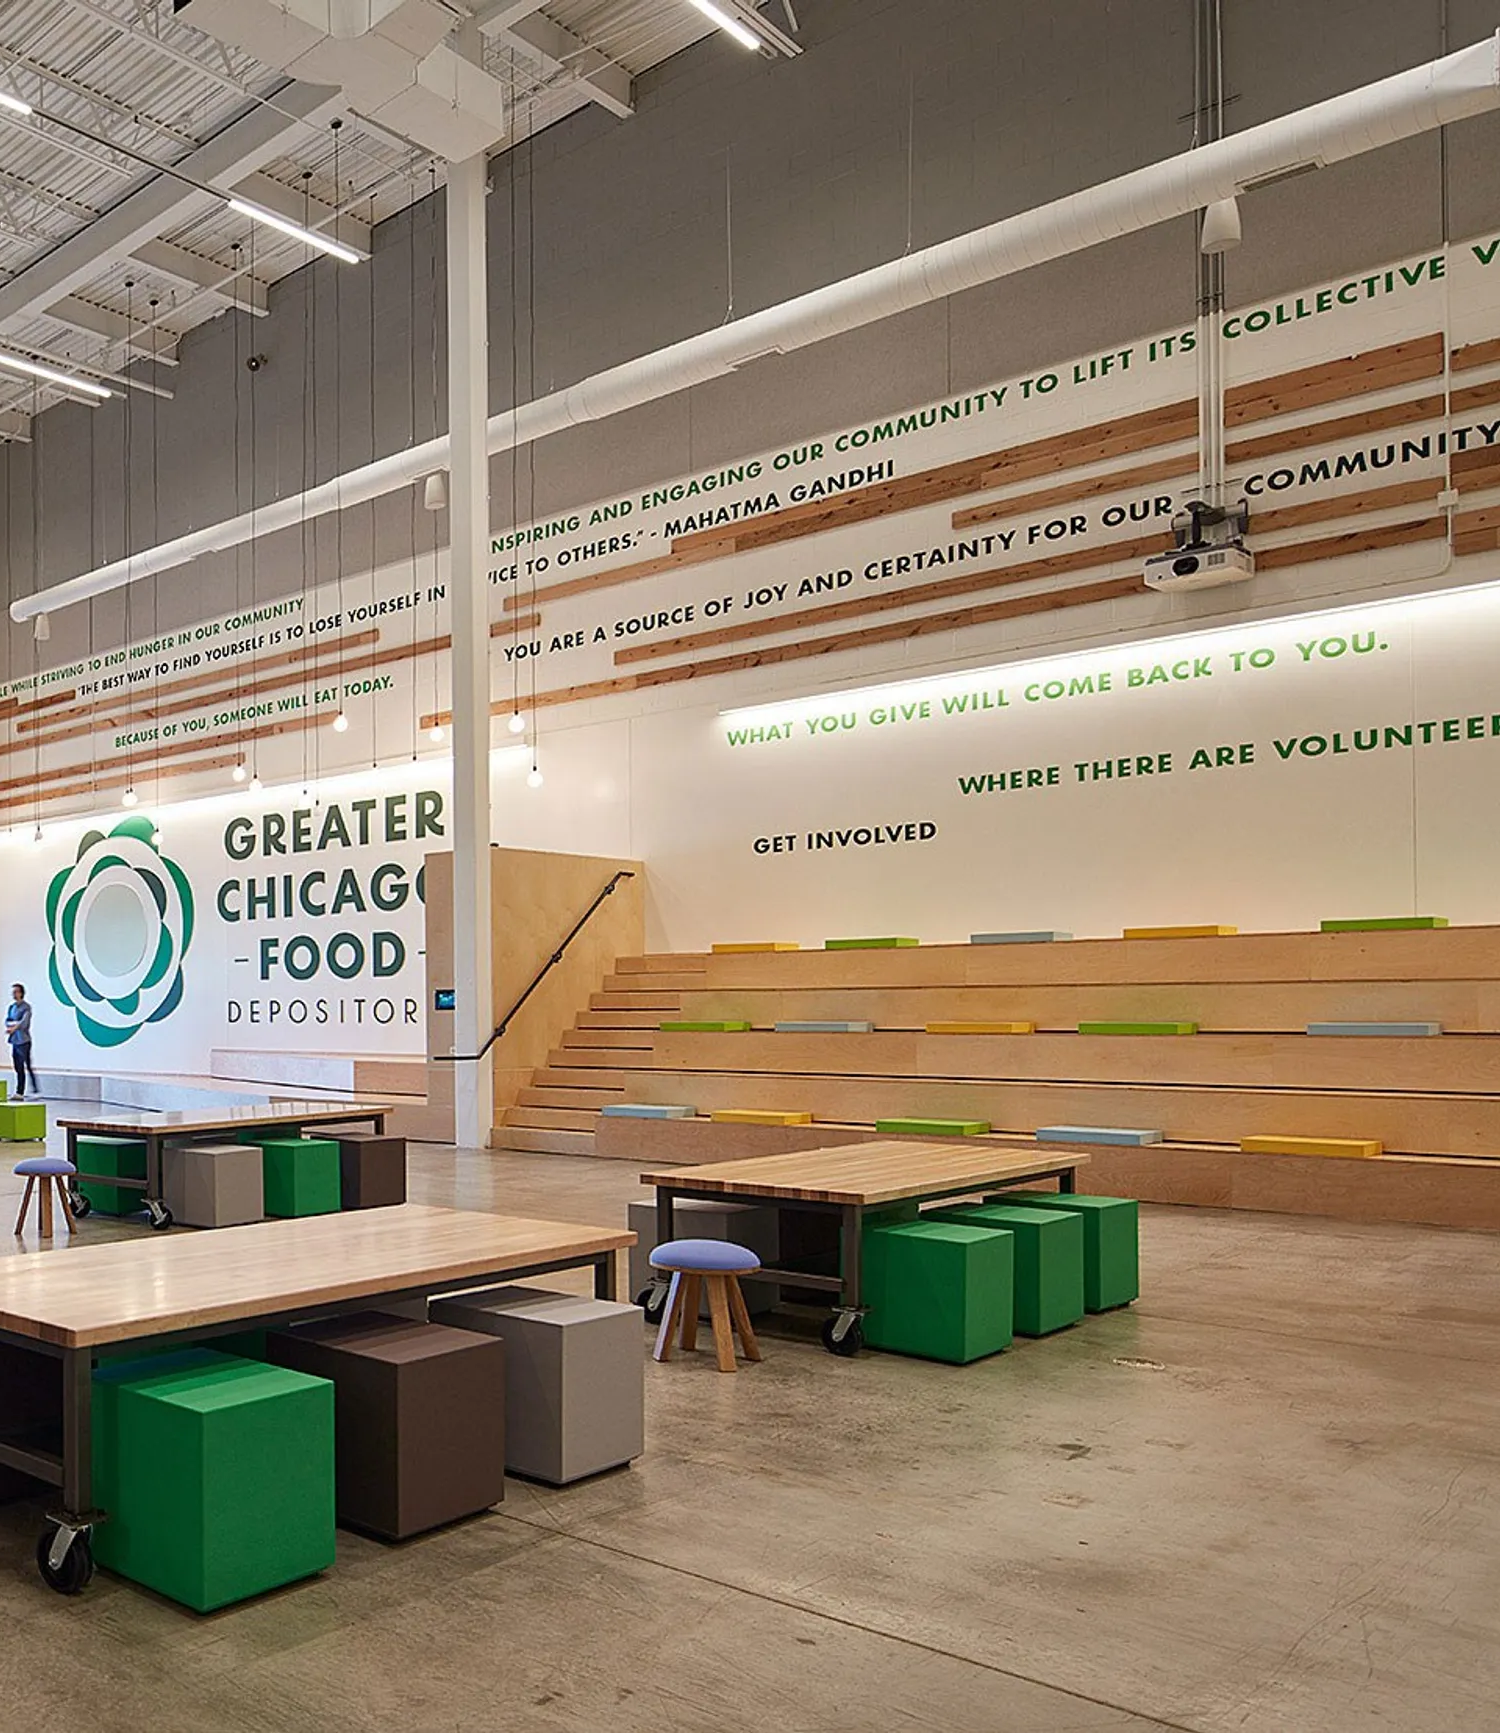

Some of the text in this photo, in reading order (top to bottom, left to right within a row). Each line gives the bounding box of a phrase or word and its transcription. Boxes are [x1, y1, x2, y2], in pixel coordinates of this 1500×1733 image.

[589, 501, 632, 526] AND
[641, 461, 763, 510] ENGAGING
[772, 443, 824, 470] OUR
[834, 386, 1008, 452] COMMUNITY
[1019, 373, 1059, 399] TO
[1073, 348, 1133, 384] LIFT
[1149, 331, 1197, 362] ITS
[1222, 255, 1446, 339] COLLECTIVE
[504, 420, 1500, 662] YOU ARE A SOURCE OF JOY AND CERTAINTY FOR OUR COMMUNITY
[525, 556, 549, 576] TO
[664, 492, 780, 539] MAHATMA
[789, 459, 894, 502] GANDHI
[11, 676, 38, 694] WHILE
[40, 663, 84, 686] STRIVING
[88, 658, 101, 672] TO
[104, 650, 126, 667] END
[129, 636, 175, 660] HUNGER
[178, 632, 192, 646] IN
[195, 623, 220, 640] OUR
[224, 598, 304, 632] COMMUNITY
[102, 674, 125, 690] BEST
[127, 667, 151, 686] WAY
[154, 662, 169, 677] TO
[173, 653, 201, 671] FIND
[205, 635, 265, 662] YOURSELF
[269, 630, 282, 645] IS
[286, 624, 304, 640] TO
[309, 613, 342, 634] LOSE
[347, 591, 421, 623] YOURSELF
[427, 584, 446, 602] IN
[114, 675, 394, 748] BECAUSE OF YOU, SOMEONE WILL EAT TODAY.
[726, 630, 1389, 747] WHAT YOU GIVE WILL COME BACK TO YOU.
[957, 766, 1060, 795] WHERE
[1074, 752, 1172, 782] THERE
[1188, 743, 1255, 770] ARE
[224, 790, 445, 860] GREATER
[753, 821, 936, 854] GET INVOLVED
[216, 863, 426, 923] CHICAG
[259, 930, 406, 981] FOOD
